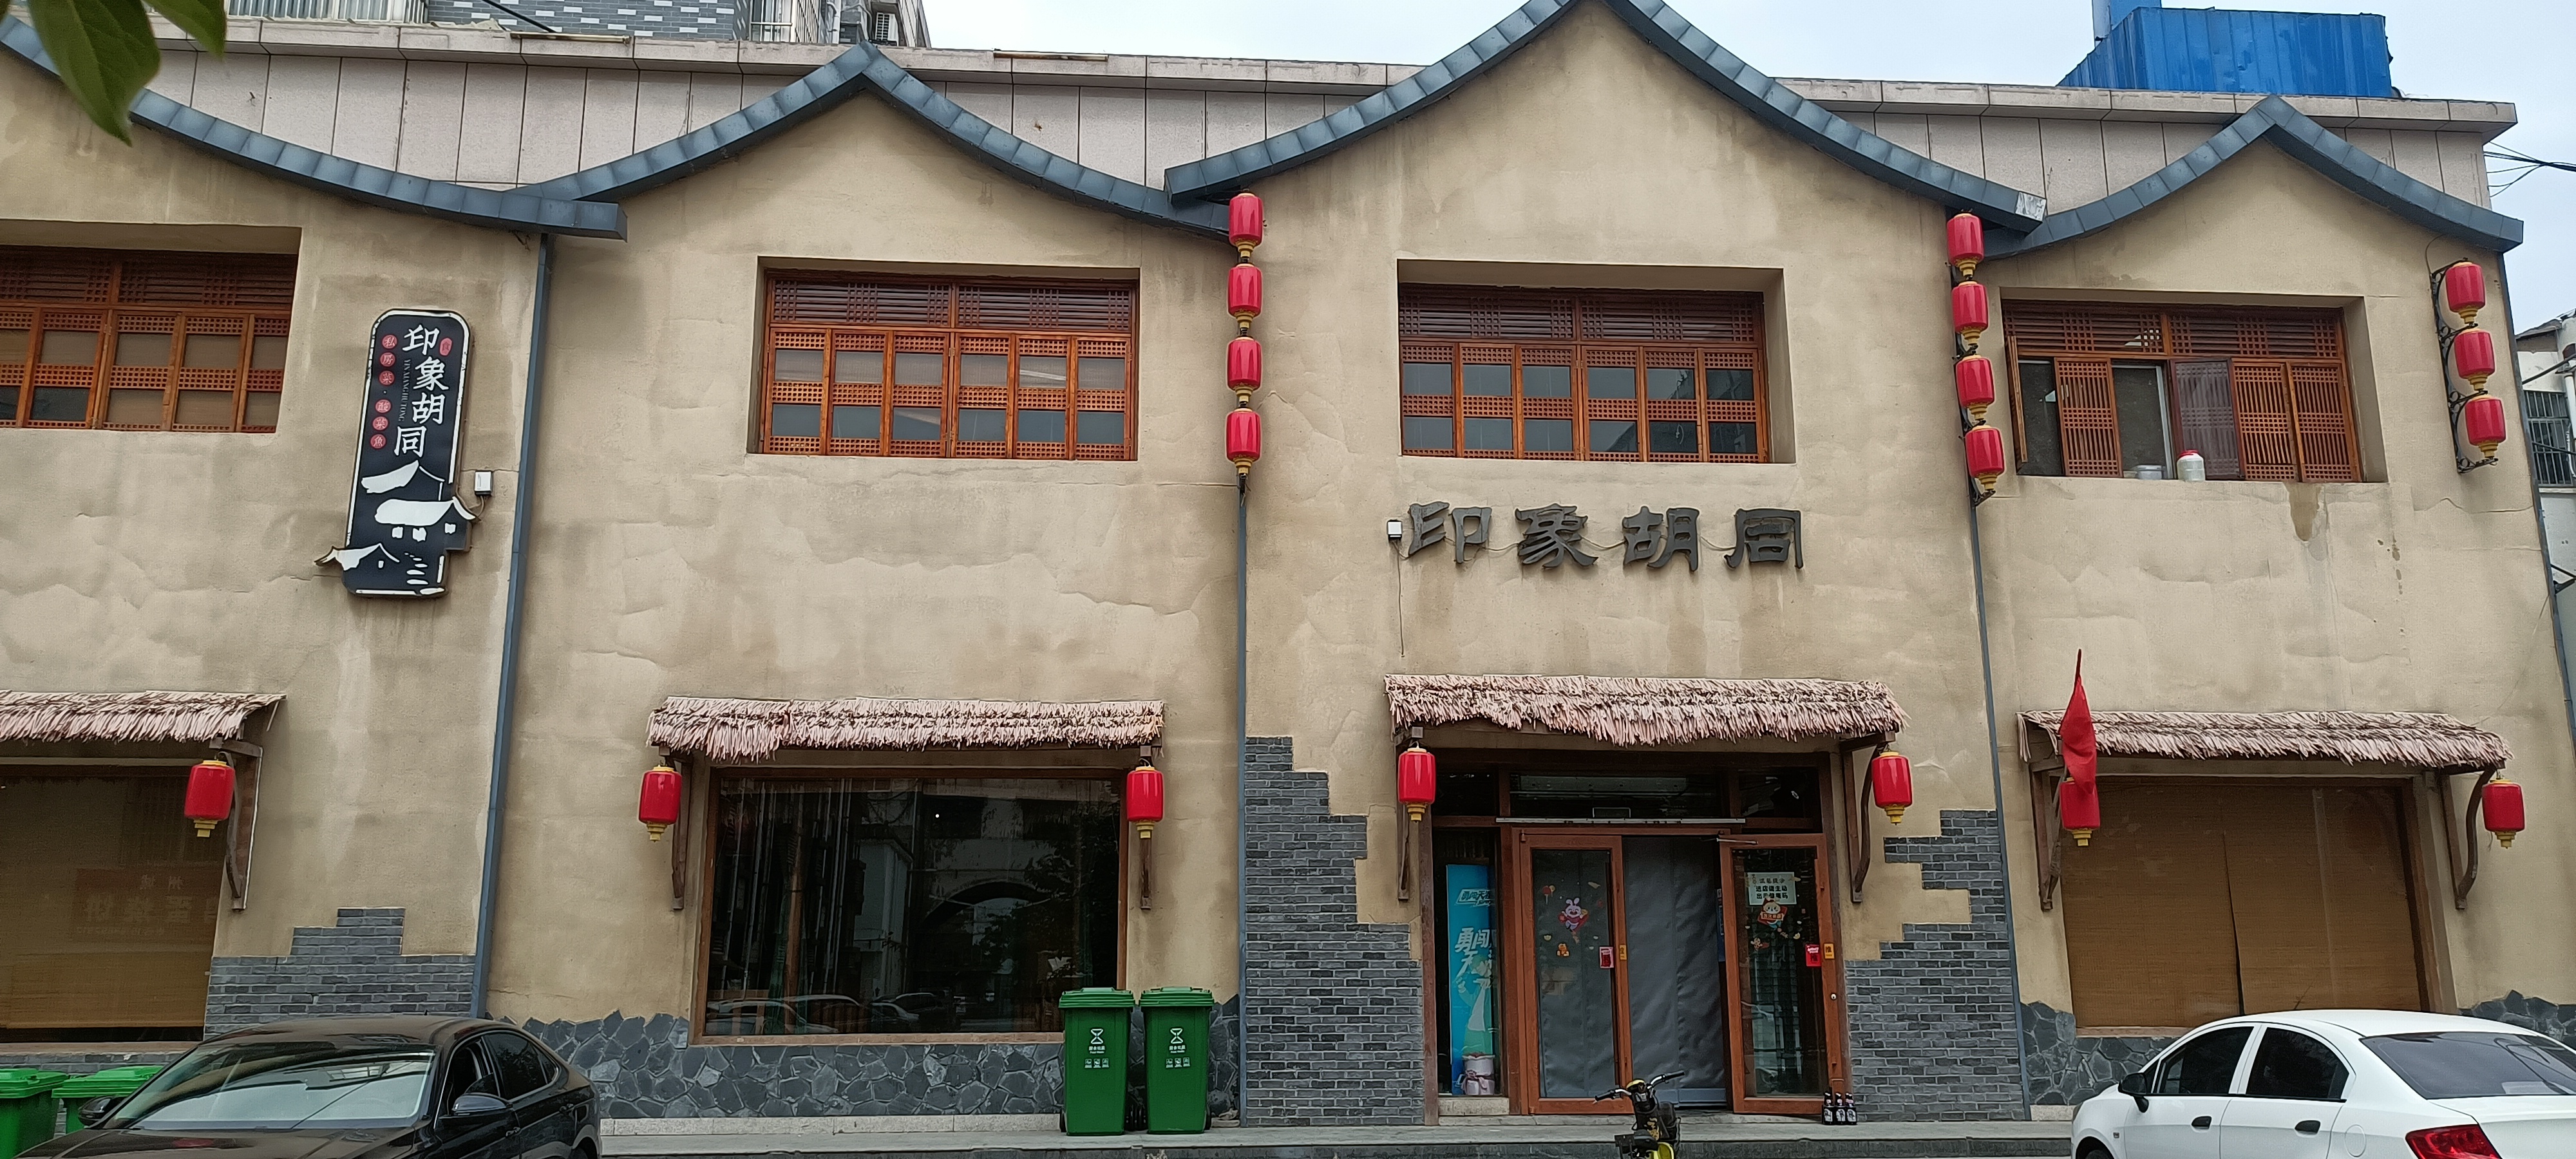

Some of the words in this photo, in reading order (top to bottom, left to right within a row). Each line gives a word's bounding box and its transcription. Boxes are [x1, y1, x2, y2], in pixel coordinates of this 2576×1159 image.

[394, 324, 450, 458] 印象胡同
[1408, 500, 1803, 572] 印象胡同
[1455, 927, 1490, 953] 勇闯
